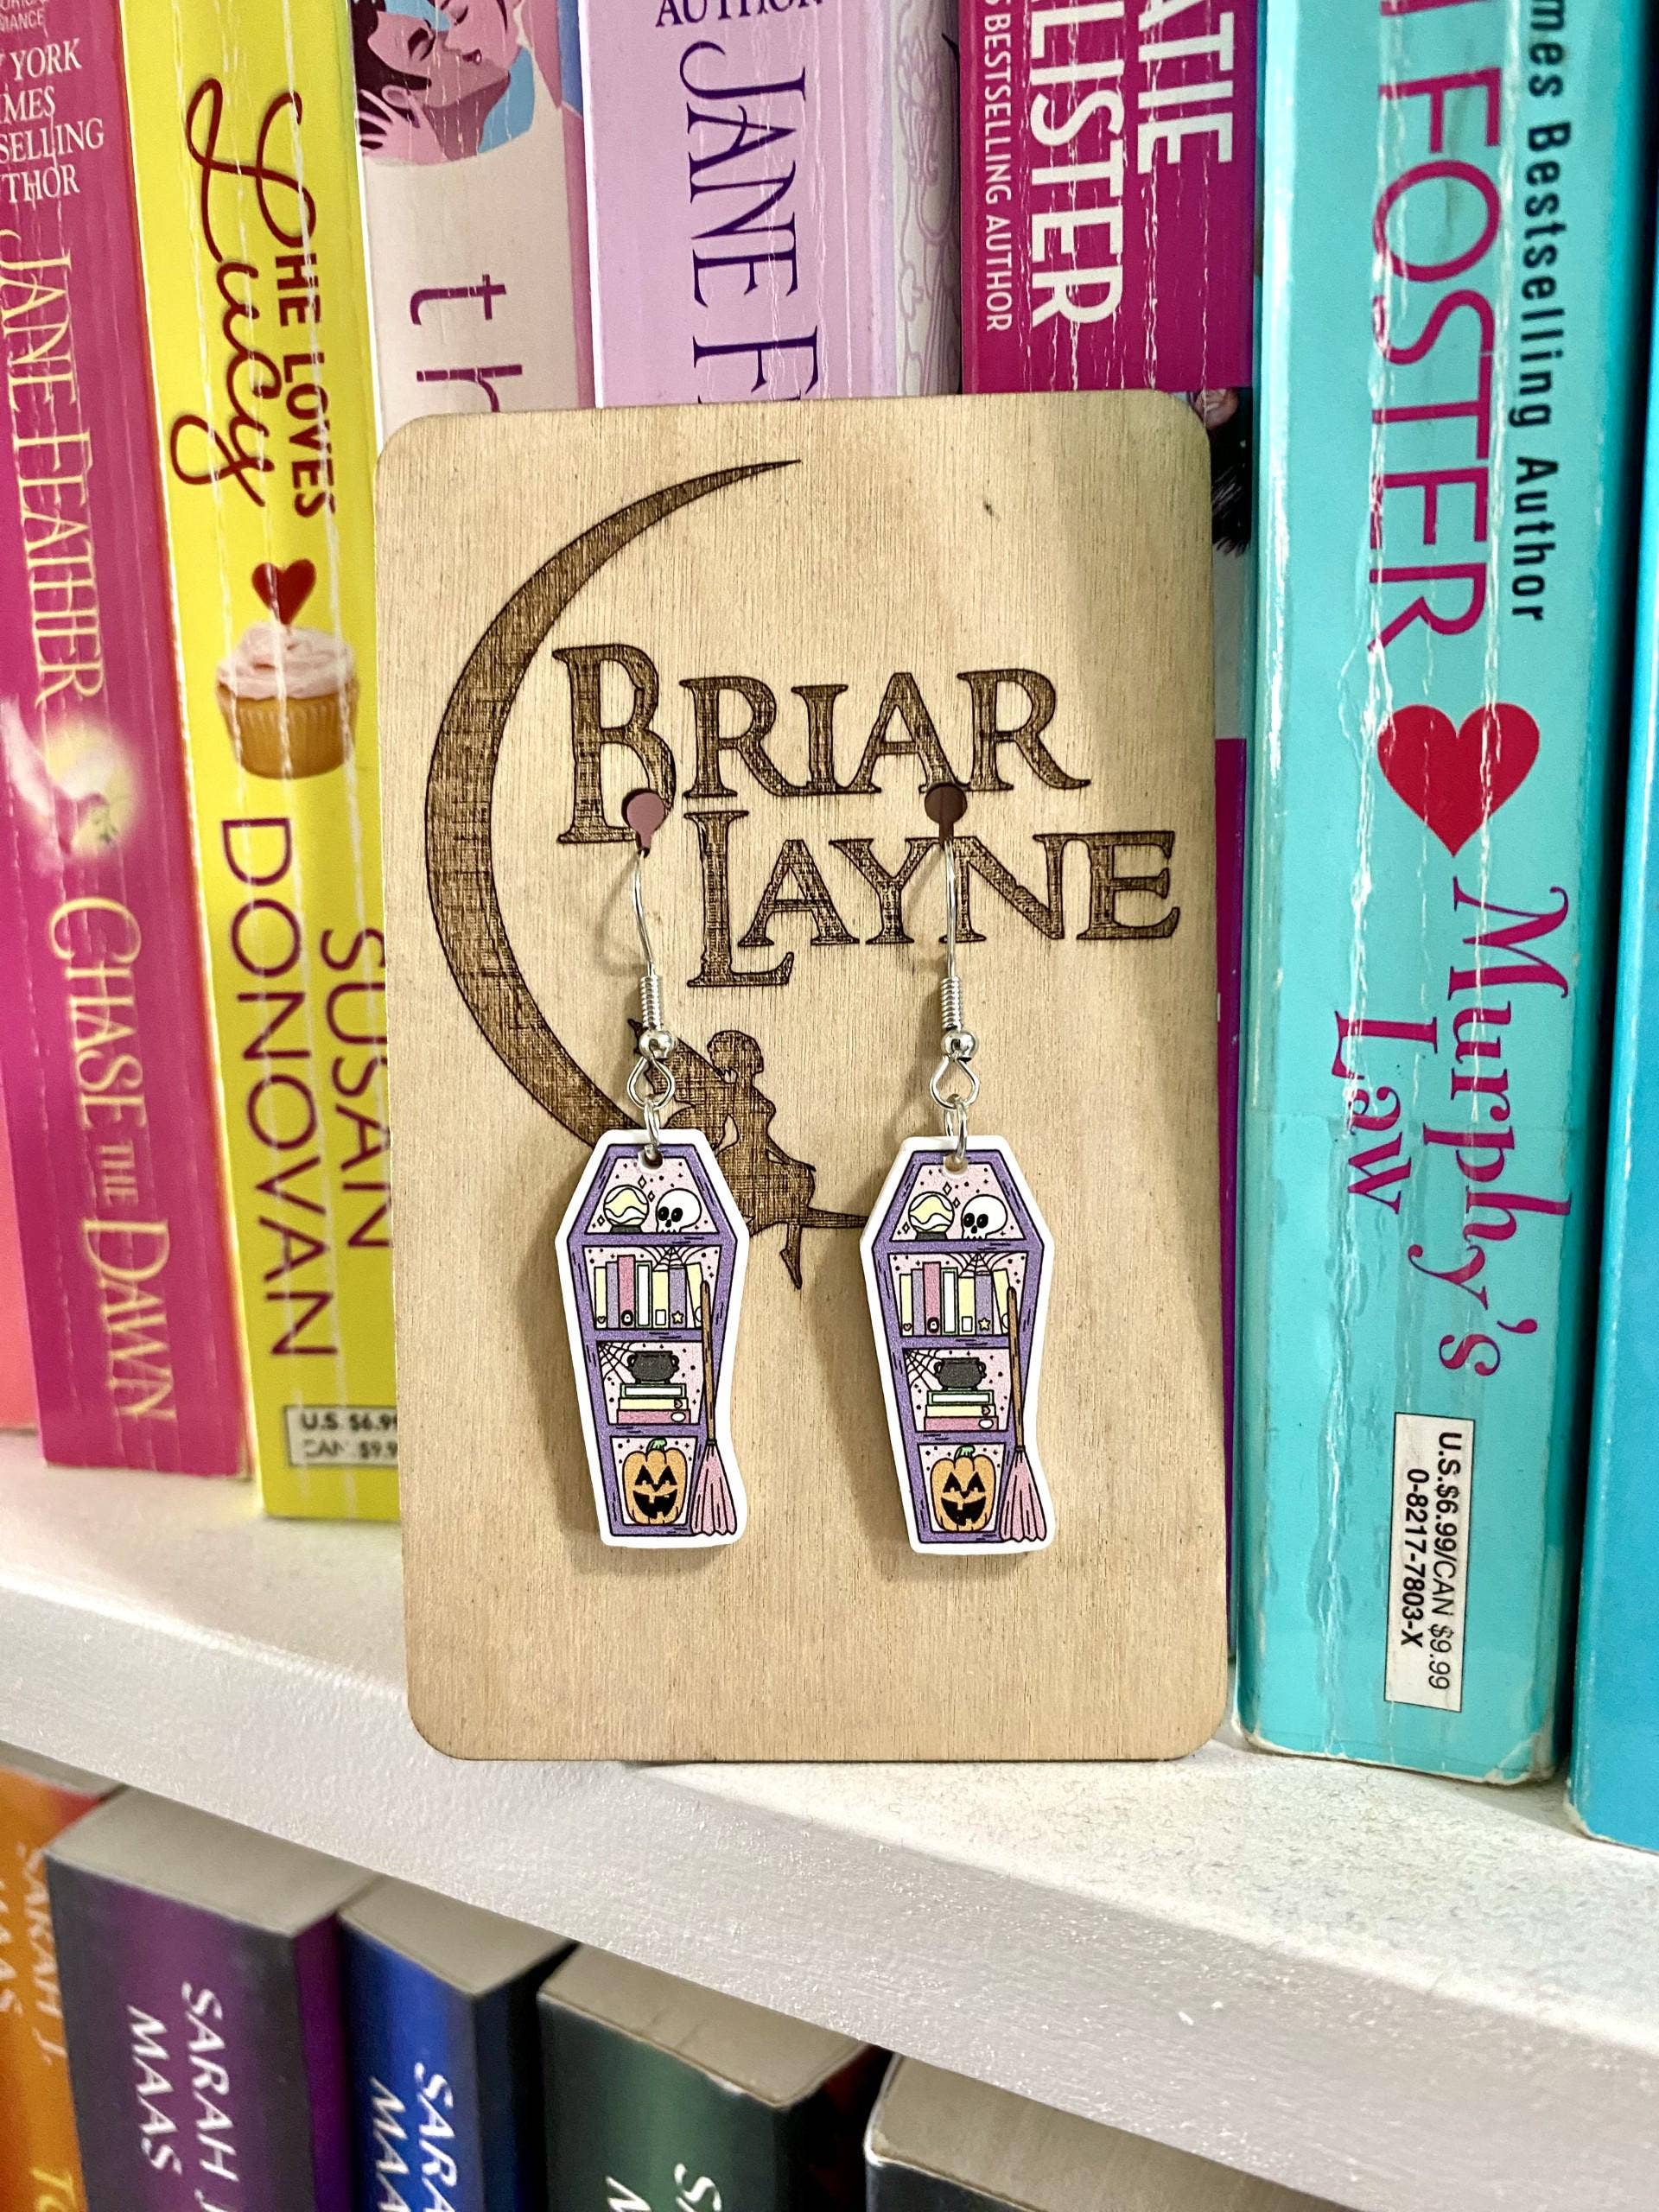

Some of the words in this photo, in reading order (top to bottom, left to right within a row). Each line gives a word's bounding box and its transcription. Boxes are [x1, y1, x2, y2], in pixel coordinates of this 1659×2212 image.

[0, 86, 55, 125] MES
[10, 38, 82, 81] YORK
[655, 0, 822, 28] AUTH
[679, 41, 807, 308] JANE
[984, 13, 1012, 206] BESTSELLING
[1029, 0, 1124, 328] LISTER
[0, 229, 76, 411] JANE
[693, 325, 819, 404] F
[985, 213, 1013, 332] AUTHOR
[1367, 67, 1503, 654] FOSTER
[1509, 122, 1572, 429] Bestselling
[283, 353, 336, 518] LOVES
[12, 427, 105, 710] FEATHER
[1511, 455, 1558, 621] Author
[553, 644, 1091, 845] BRIAR
[686, 809, 1181, 988] LAYNE
[48, 897, 147, 1128] CHASE
[220, 817, 338, 1357] DONOVAN
[320, 927, 394, 1249] SUSAN
[95, 1140, 139, 1207] THE
[1332, 1011, 1438, 1215] Law
[1408, 876, 1572, 1377] Murphy's
[81, 1219, 178, 1423] DAWN
[1400, 1468, 1431, 1649] 0-8217-7803-X
[1431, 1431, 1463, 1618] U.S.$6.99/CAN
[1427, 1624, 1455, 1691] $9.99
[126, 2005, 183, 2176] MAAS
[181, 1982, 239, 2183] SARAH
[674, 2163, 722, 2212] S
